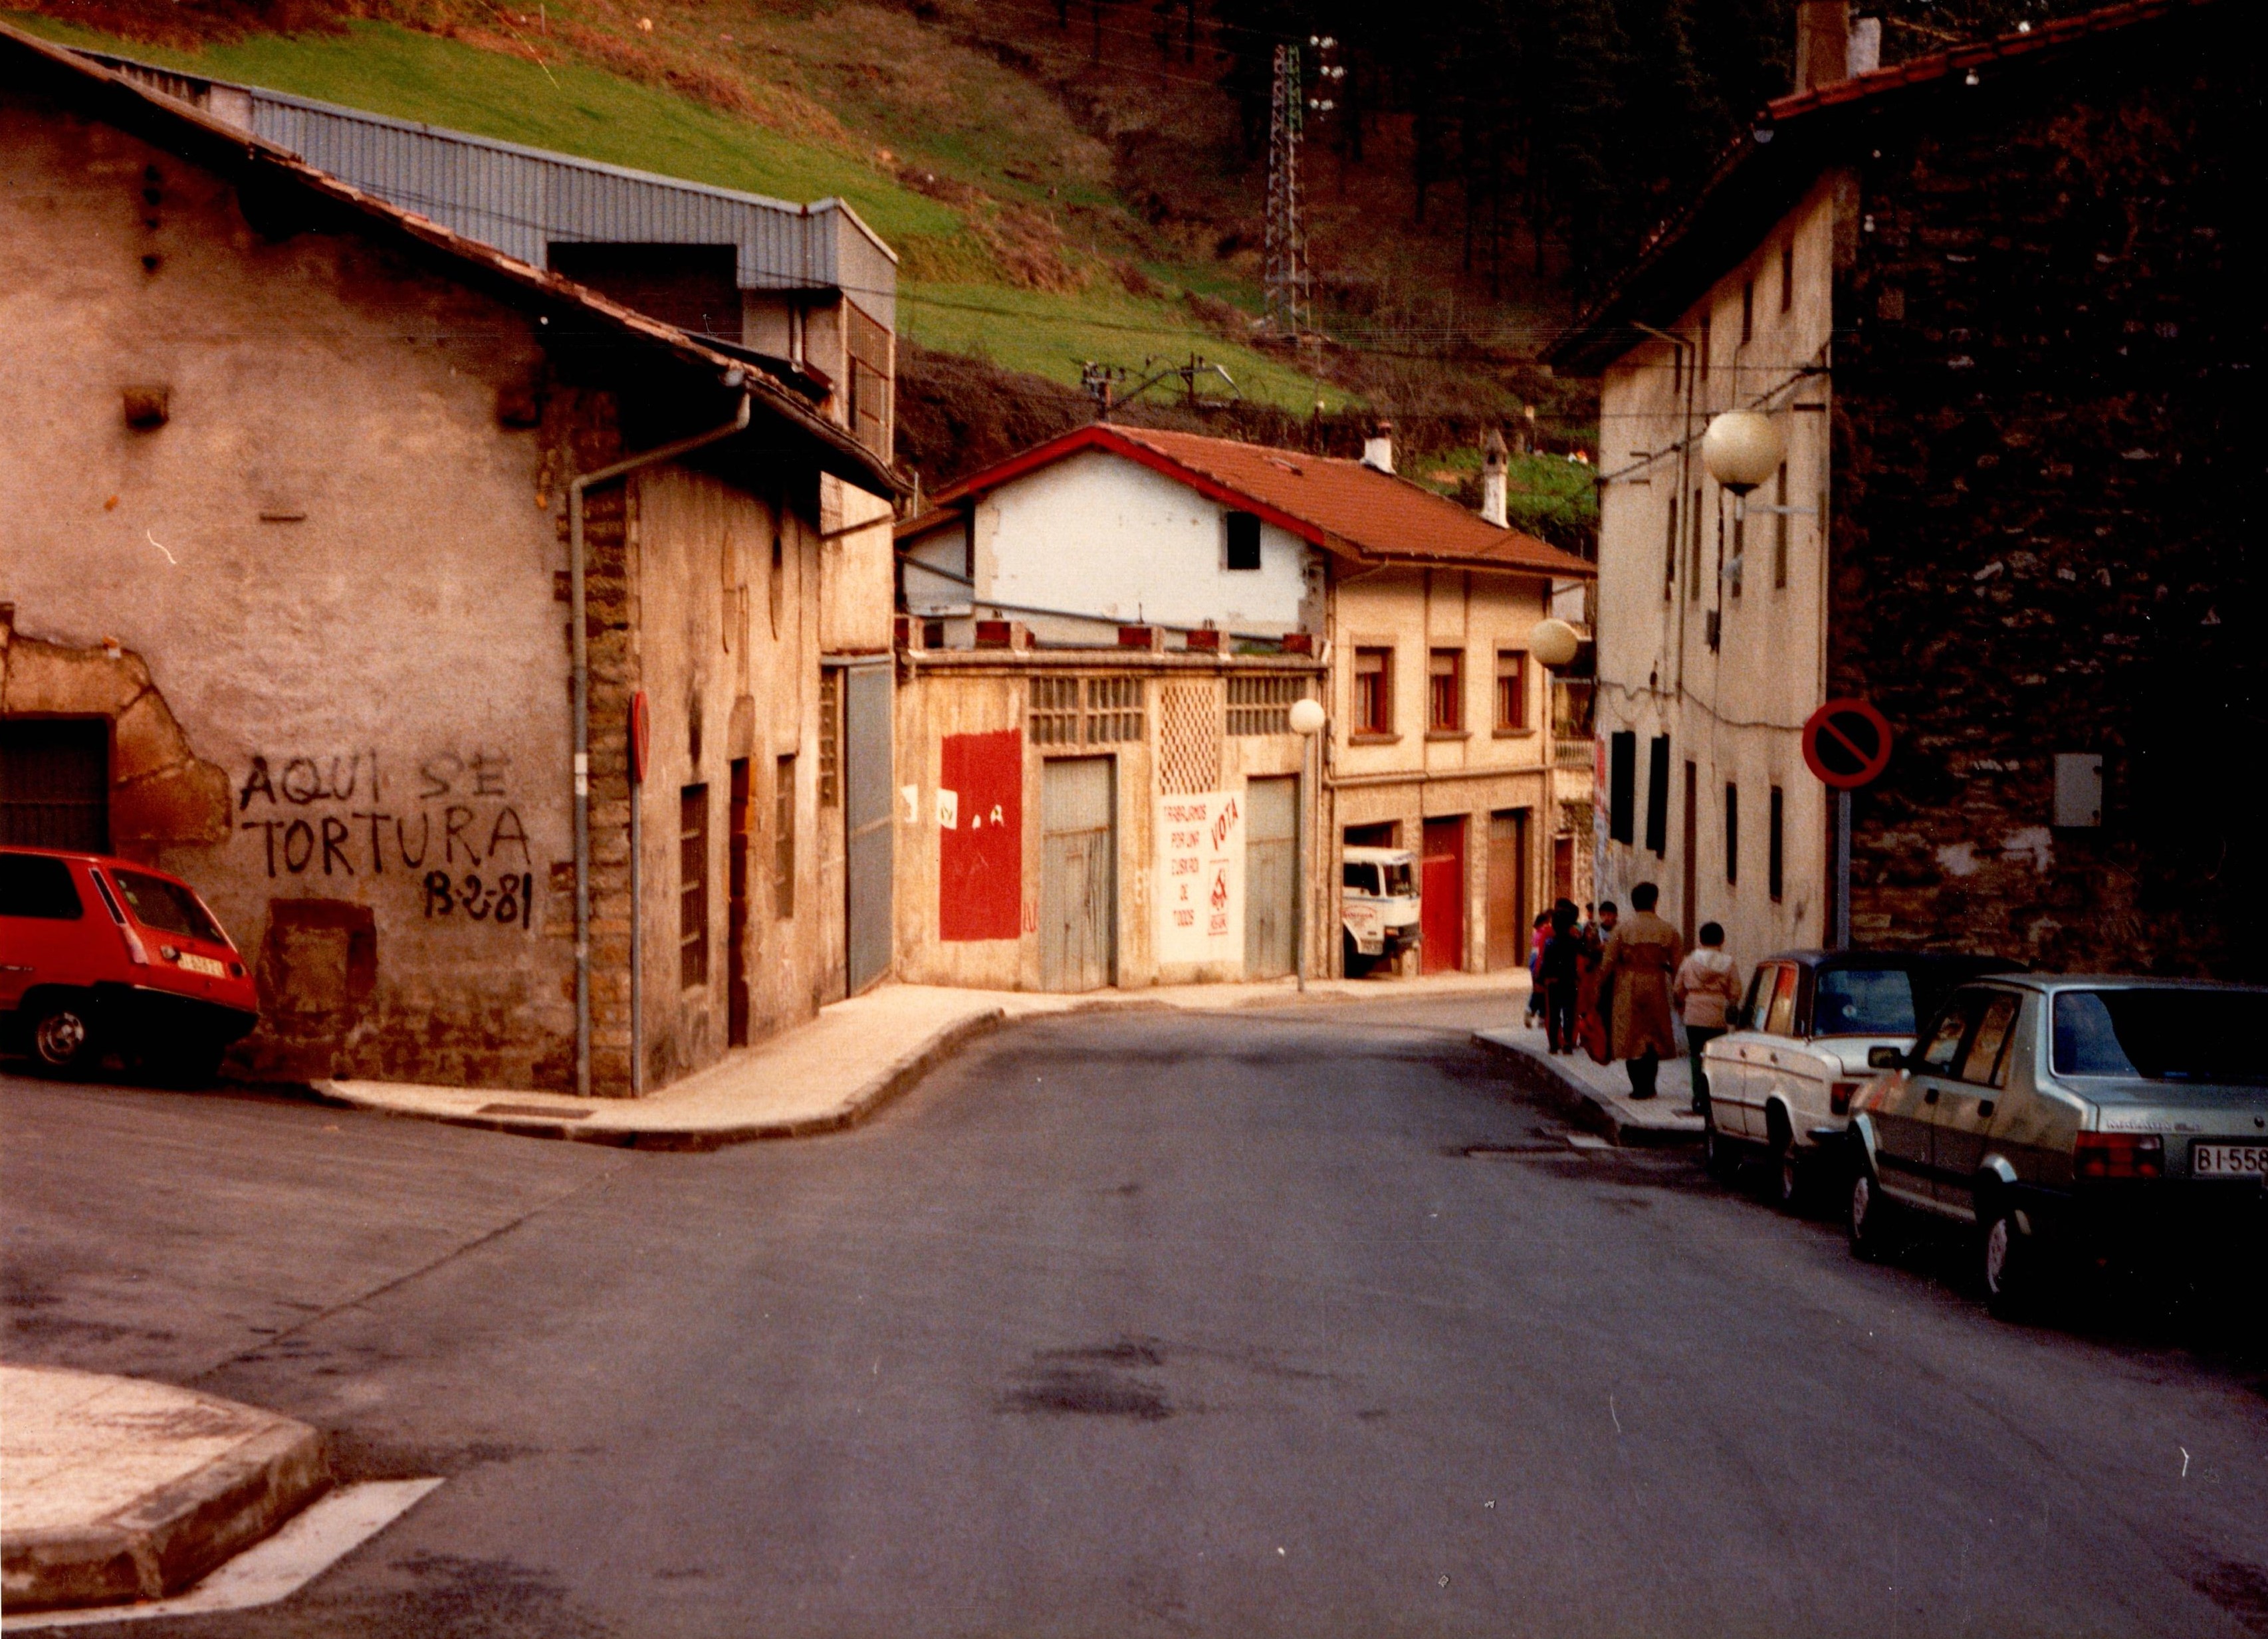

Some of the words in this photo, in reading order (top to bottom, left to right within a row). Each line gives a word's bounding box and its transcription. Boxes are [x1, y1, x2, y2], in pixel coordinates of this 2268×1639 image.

[239, 748, 380, 810] AQUI
[420, 748, 512, 800] SE
[241, 804, 531, 878] TORTURA
[1211, 797, 1238, 851] VOTA
